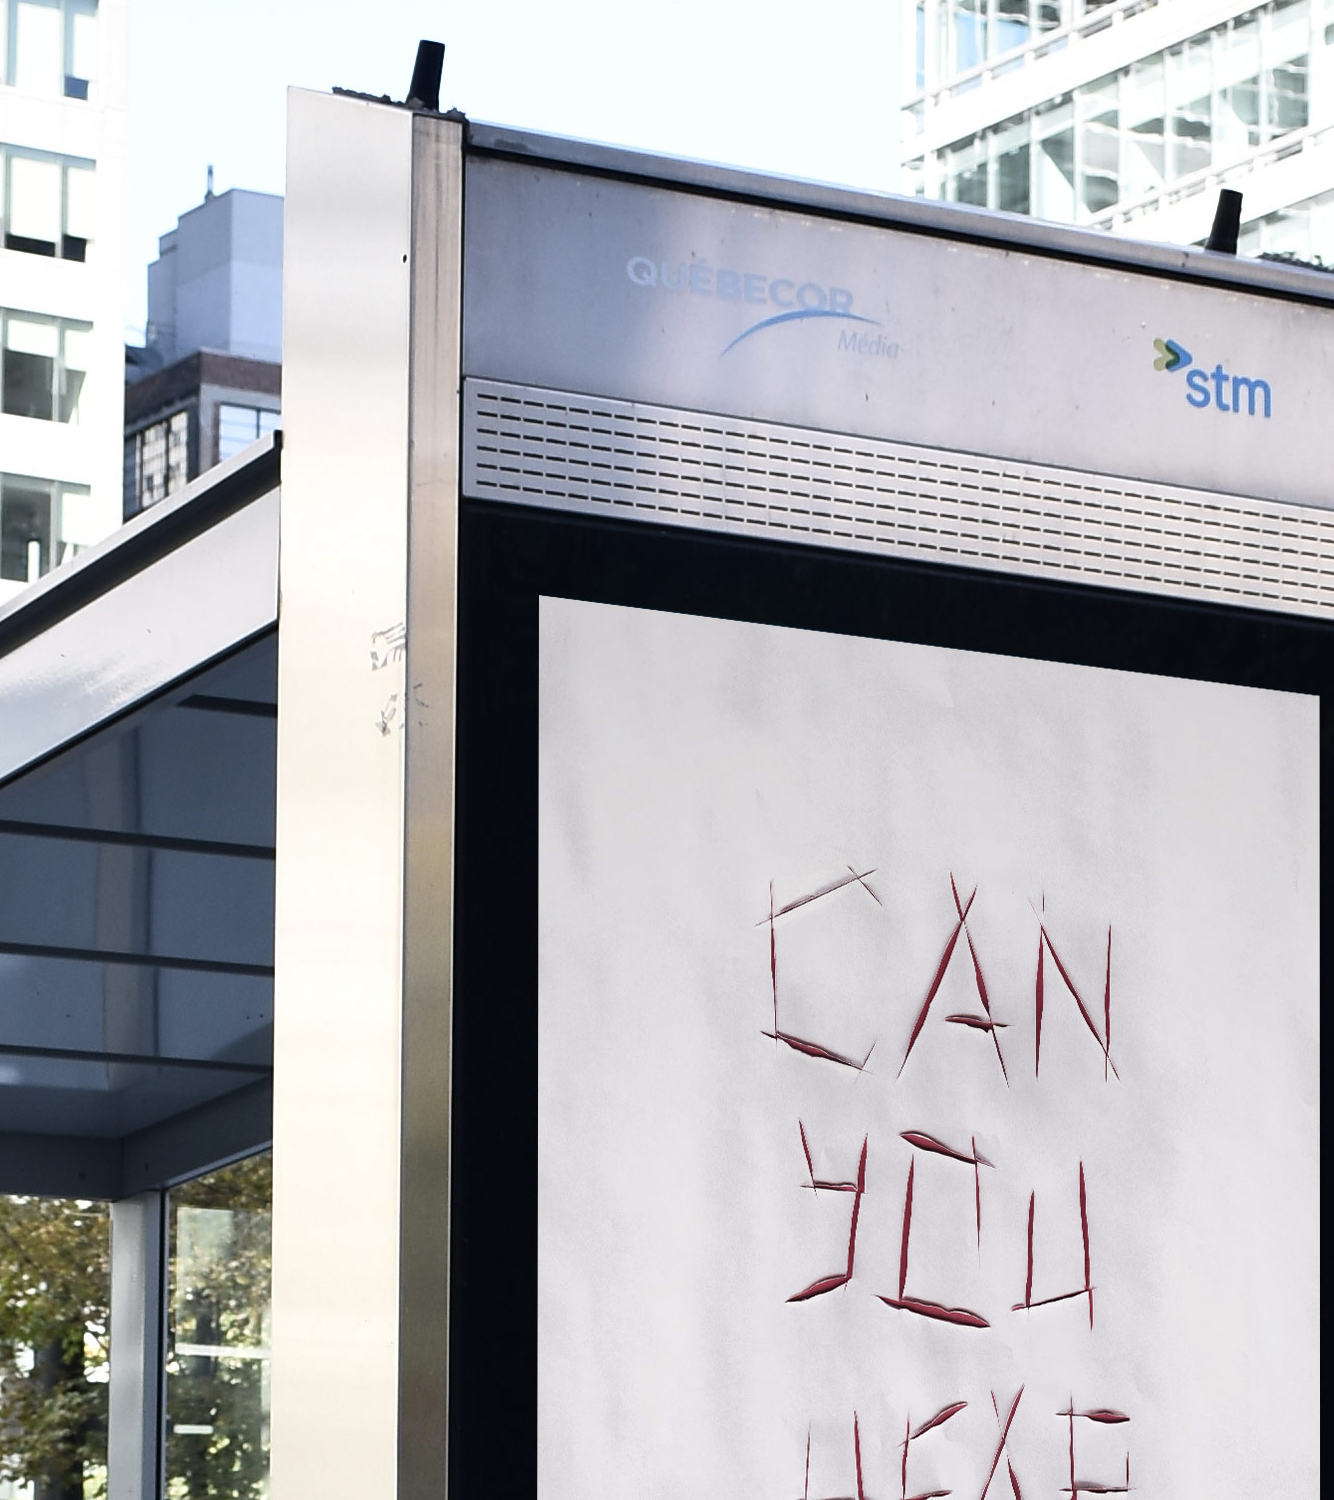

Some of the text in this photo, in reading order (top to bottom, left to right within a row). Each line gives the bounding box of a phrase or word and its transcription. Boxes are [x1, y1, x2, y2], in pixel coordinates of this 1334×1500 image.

[1185, 363, 1272, 418] stm
[755, 865, 1122, 1088] CAN
[784, 1117, 1097, 1331] YOU
